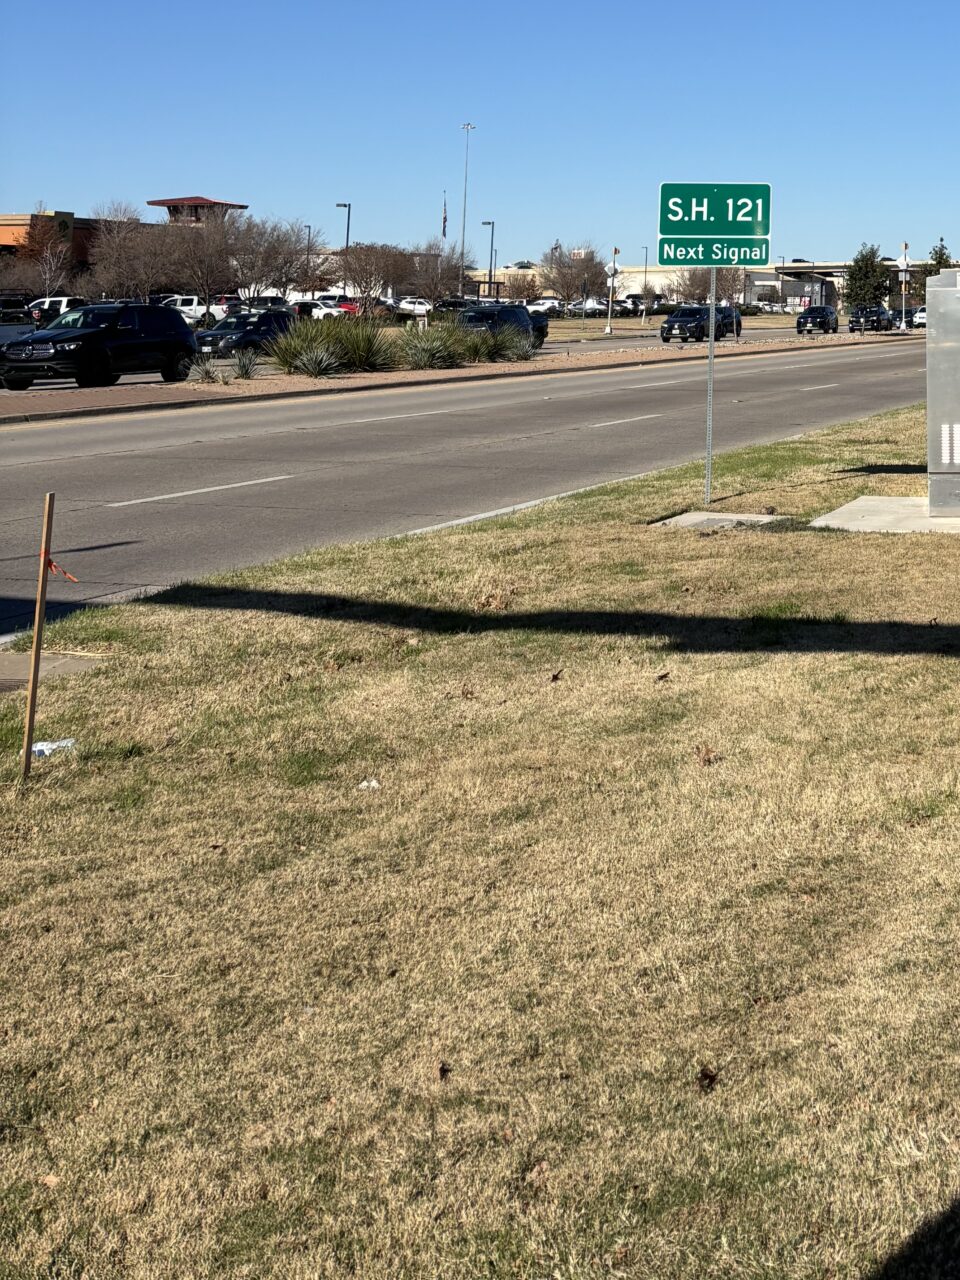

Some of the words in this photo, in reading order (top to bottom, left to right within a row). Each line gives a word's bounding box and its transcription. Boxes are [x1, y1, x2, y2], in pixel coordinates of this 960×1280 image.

[667, 197, 715, 222] S.H.
[726, 198, 763, 222] 121
[663, 243, 705, 260] Next
[711, 243, 766, 265] Signal
